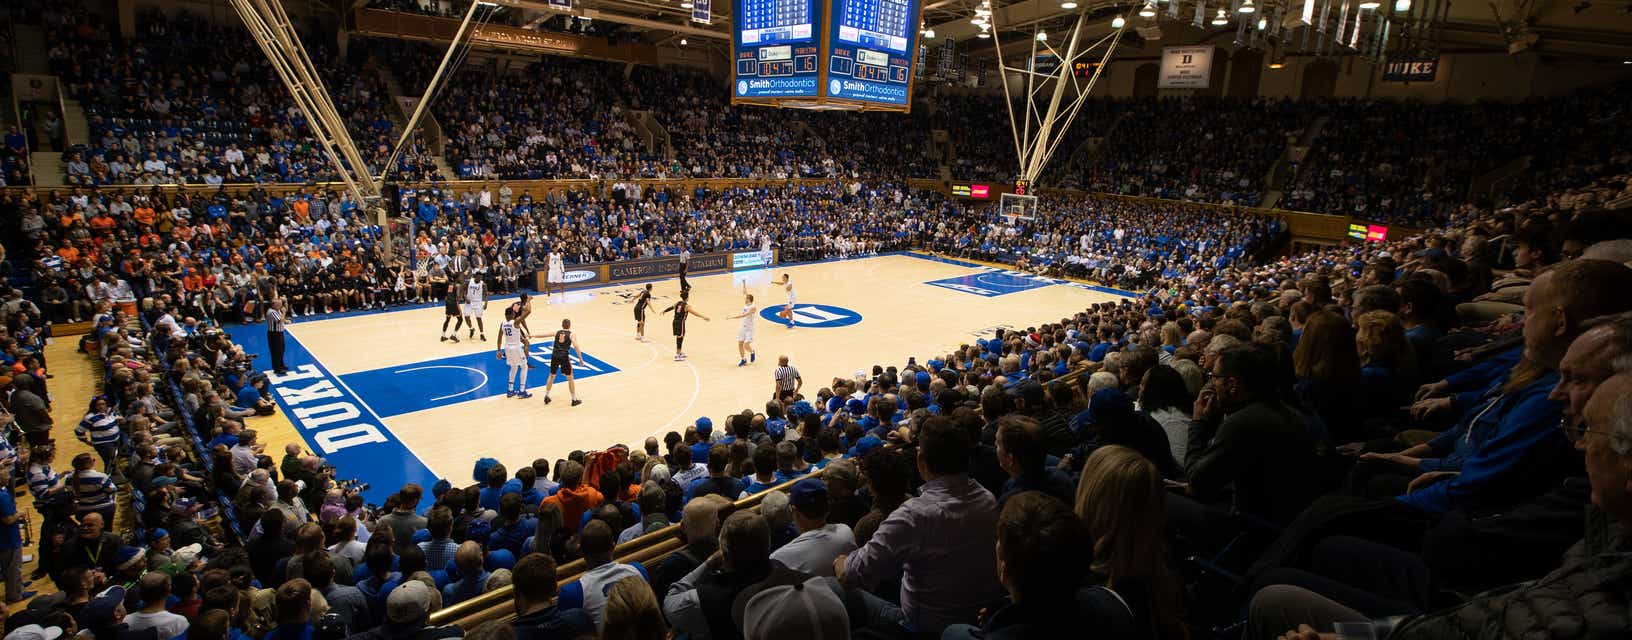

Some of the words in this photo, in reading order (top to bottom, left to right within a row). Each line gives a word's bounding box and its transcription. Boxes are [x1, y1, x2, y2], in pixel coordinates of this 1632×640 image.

[804, 57, 813, 71] 16
[613, 263, 655, 277] CAMERON
[263, 363, 389, 455] DUKE
